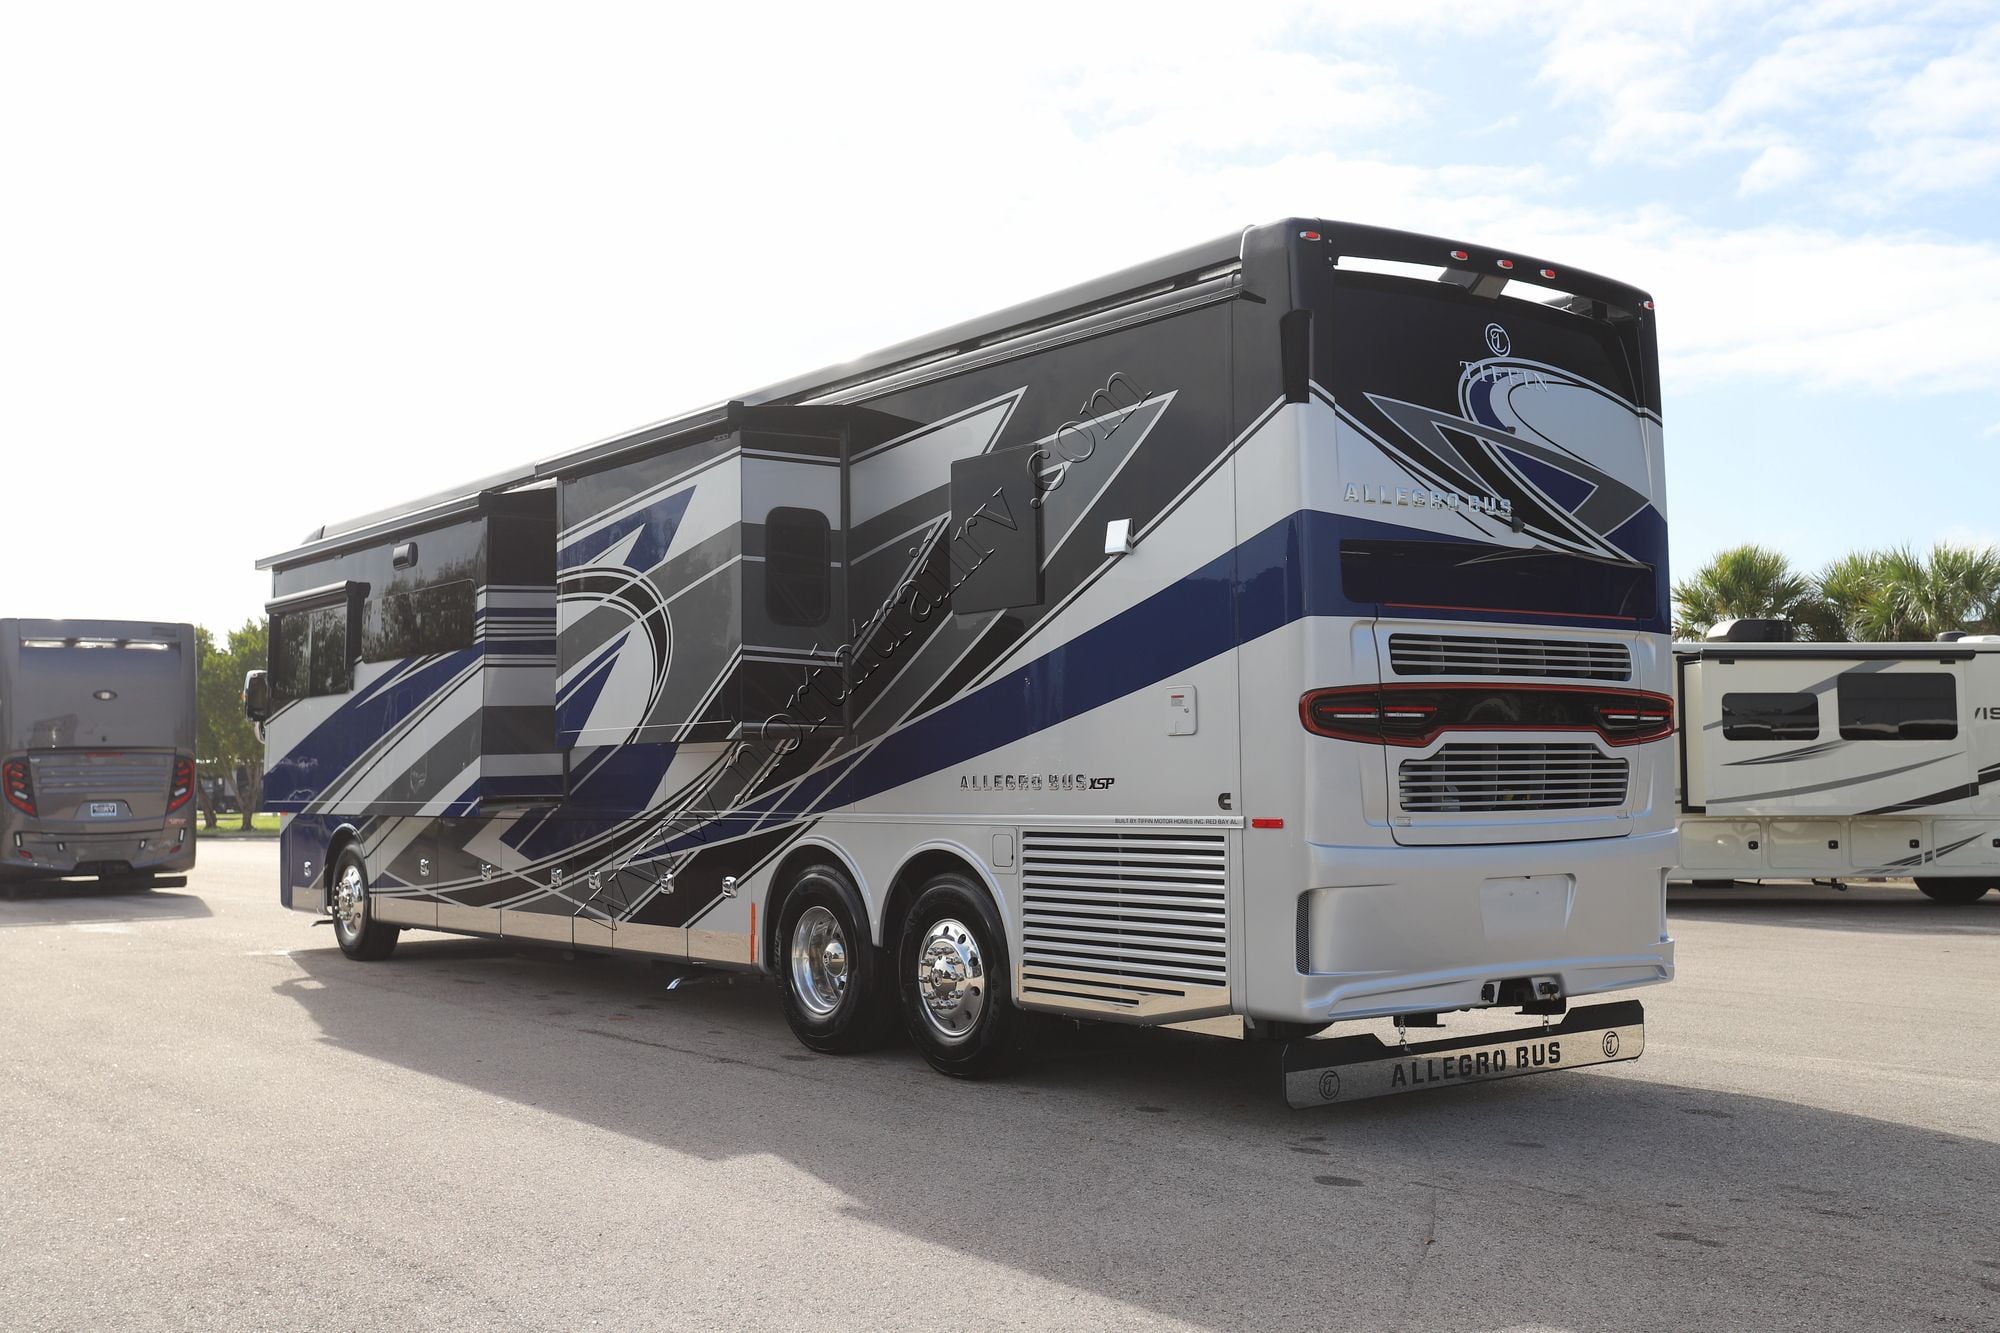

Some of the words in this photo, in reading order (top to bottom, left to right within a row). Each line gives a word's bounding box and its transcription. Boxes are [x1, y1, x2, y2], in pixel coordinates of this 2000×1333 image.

[1460, 361, 1548, 392] TIFFIN
[1344, 482, 1460, 512] ALLEGRO
[1468, 498, 1513, 517] BUS
[960, 775, 1042, 791] ALLEGRO
[1048, 774, 1086, 790] BUS
[1088, 777, 1115, 790] XSP
[1391, 1050, 1506, 1088] ALLEGRO
[1516, 1042, 1562, 1070] BUS
